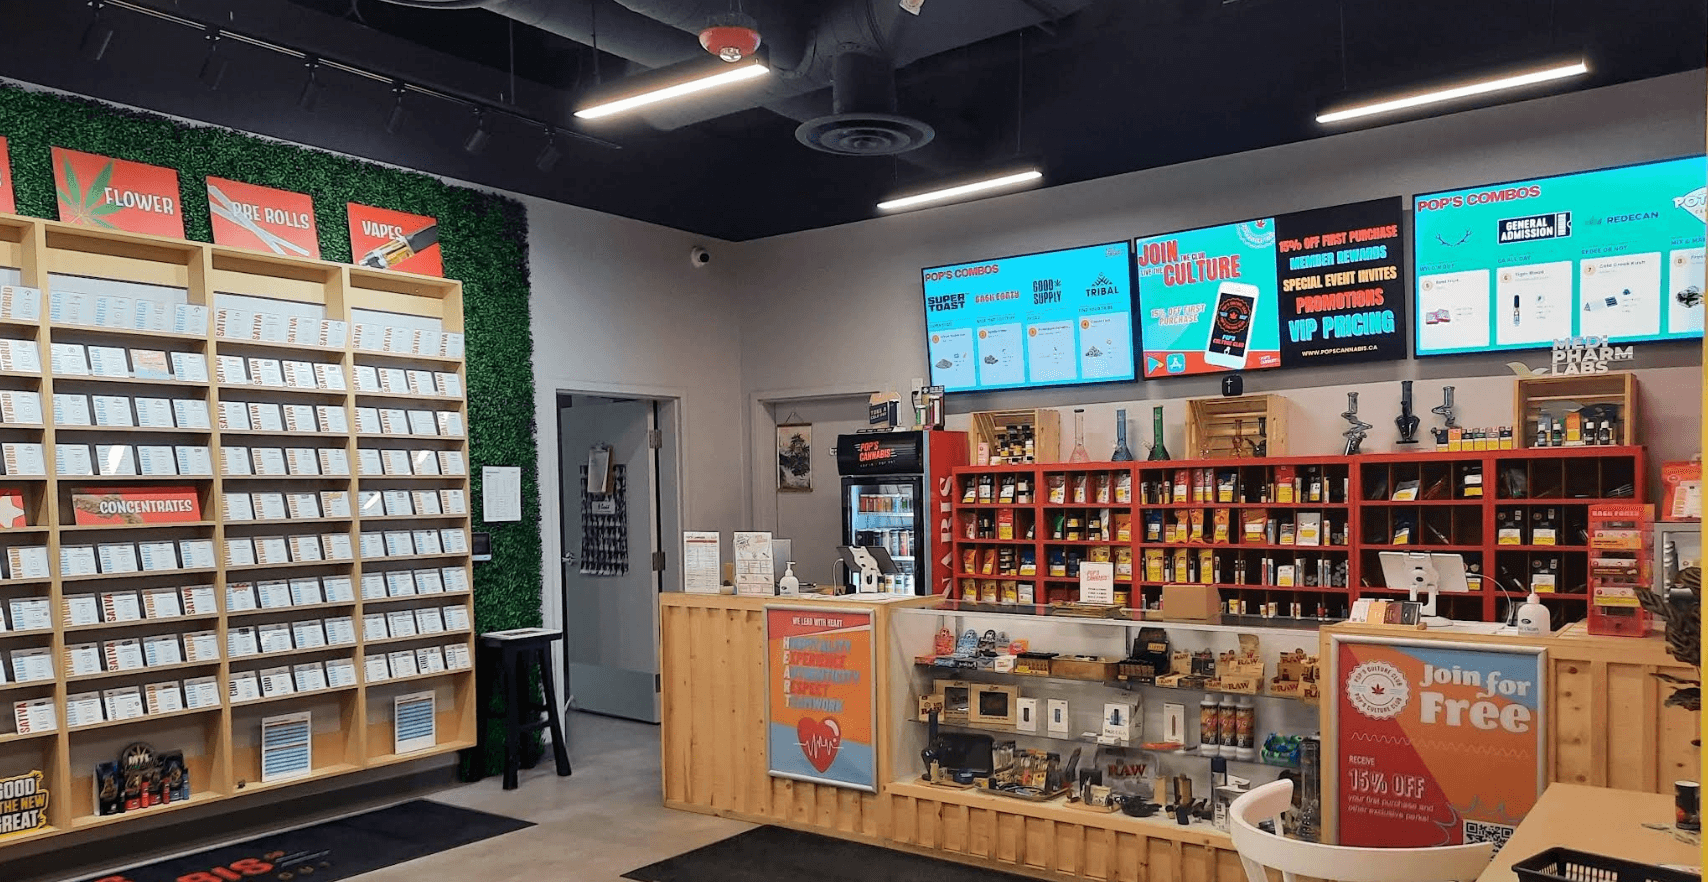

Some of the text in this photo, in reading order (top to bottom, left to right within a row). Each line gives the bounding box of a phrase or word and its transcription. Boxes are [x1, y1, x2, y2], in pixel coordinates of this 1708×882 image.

[104, 187, 174, 215] FLOWER
[1417, 185, 1541, 212] POP'S COMBOS
[232, 202, 310, 230] PRE ROLLS
[1505, 217, 1548, 231] GENERAL
[1606, 211, 1659, 224] REDECAN
[362, 220, 402, 240] VAPES
[1279, 224, 1398, 253] 15% OFF FIRST PURCHASE
[1500, 226, 1554, 241] ADMISSION
[1138, 240, 1178, 267] JOIN
[1289, 245, 1388, 271] MEMBER REWARDS
[925, 264, 999, 282] POP'S COMBOS
[1163, 254, 1240, 287] CULTURE
[1283, 266, 1397, 292] SPECIAL EVENT INVITES
[1032, 279, 1054, 293] GOOD
[1033, 291, 1062, 305] SUPPLY
[1085, 286, 1119, 297] TRIBAL
[0, 287, 13, 319] HYBRID
[928, 293, 965, 305] SUPER
[928, 301, 966, 312] TOAST
[1168, 306, 1182, 316] OFF
[1184, 304, 1205, 315] FIRST
[1296, 287, 1384, 315] PROMOTIONS
[216, 310, 227, 336] SATIVA
[252, 314, 262, 340] SATIVA
[287, 317, 298, 343] SATIVA
[1159, 313, 1198, 325] PURCHASE
[1288, 310, 1395, 343] VIP PRICING
[320, 321, 329, 346] SATIVA
[353, 324, 362, 348] SATIVA
[383, 327, 392, 352] SATIVA
[412, 330, 421, 354] SATIVA
[440, 333, 448, 357] SATIVA
[1551, 345, 1634, 365] PHARM
[216, 357, 226, 384] SATIVA
[251, 360, 262, 385] SATIVA
[285, 363, 296, 387] SATIVA
[316, 365, 328, 389] SATIVA
[1551, 360, 1609, 377] LABS
[380, 370, 391, 393] SATIVA
[408, 372, 419, 395] SATIVA
[436, 374, 446, 396] SATIVA
[2, 393, 15, 423] HYBRID
[218, 403, 228, 429] SATIVA
[250, 405, 262, 430] SATIVA
[285, 406, 297, 431] SATIVA
[318, 408, 329, 432] SATIVA
[381, 410, 392, 434] SATIVA
[859, 448, 892, 461] CANNABIS
[860, 441, 879, 452] POP'S
[5, 445, 18, 475] HYBRID
[99, 500, 193, 515] CONCENTRATES
[104, 593, 116, 622] SATIVA
[183, 587, 196, 615] SATIVA
[792, 617, 801, 625] WE
[813, 617, 826, 627] WITH
[827, 618, 843, 628] HEART
[106, 642, 118, 671] SATIVA
[1367, 665, 1391, 675] CULTURE
[1419, 664, 1532, 699] Join for
[1275, 684, 1299, 692] RAW
[16, 702, 31, 733] SATIVA
[1366, 705, 1391, 714] CULTURE
[1419, 691, 1532, 733] Free
[1107, 763, 1146, 777] RAW
[1348, 755, 1375, 766] RECEIVE
[1348, 768, 1426, 799] 15% OFF
[20, 794, 46, 810] NEW
[1347, 804, 1368, 814] other
[1368, 807, 1404, 819] exclusive
[1348, 794, 1434, 813] your first purchase and
